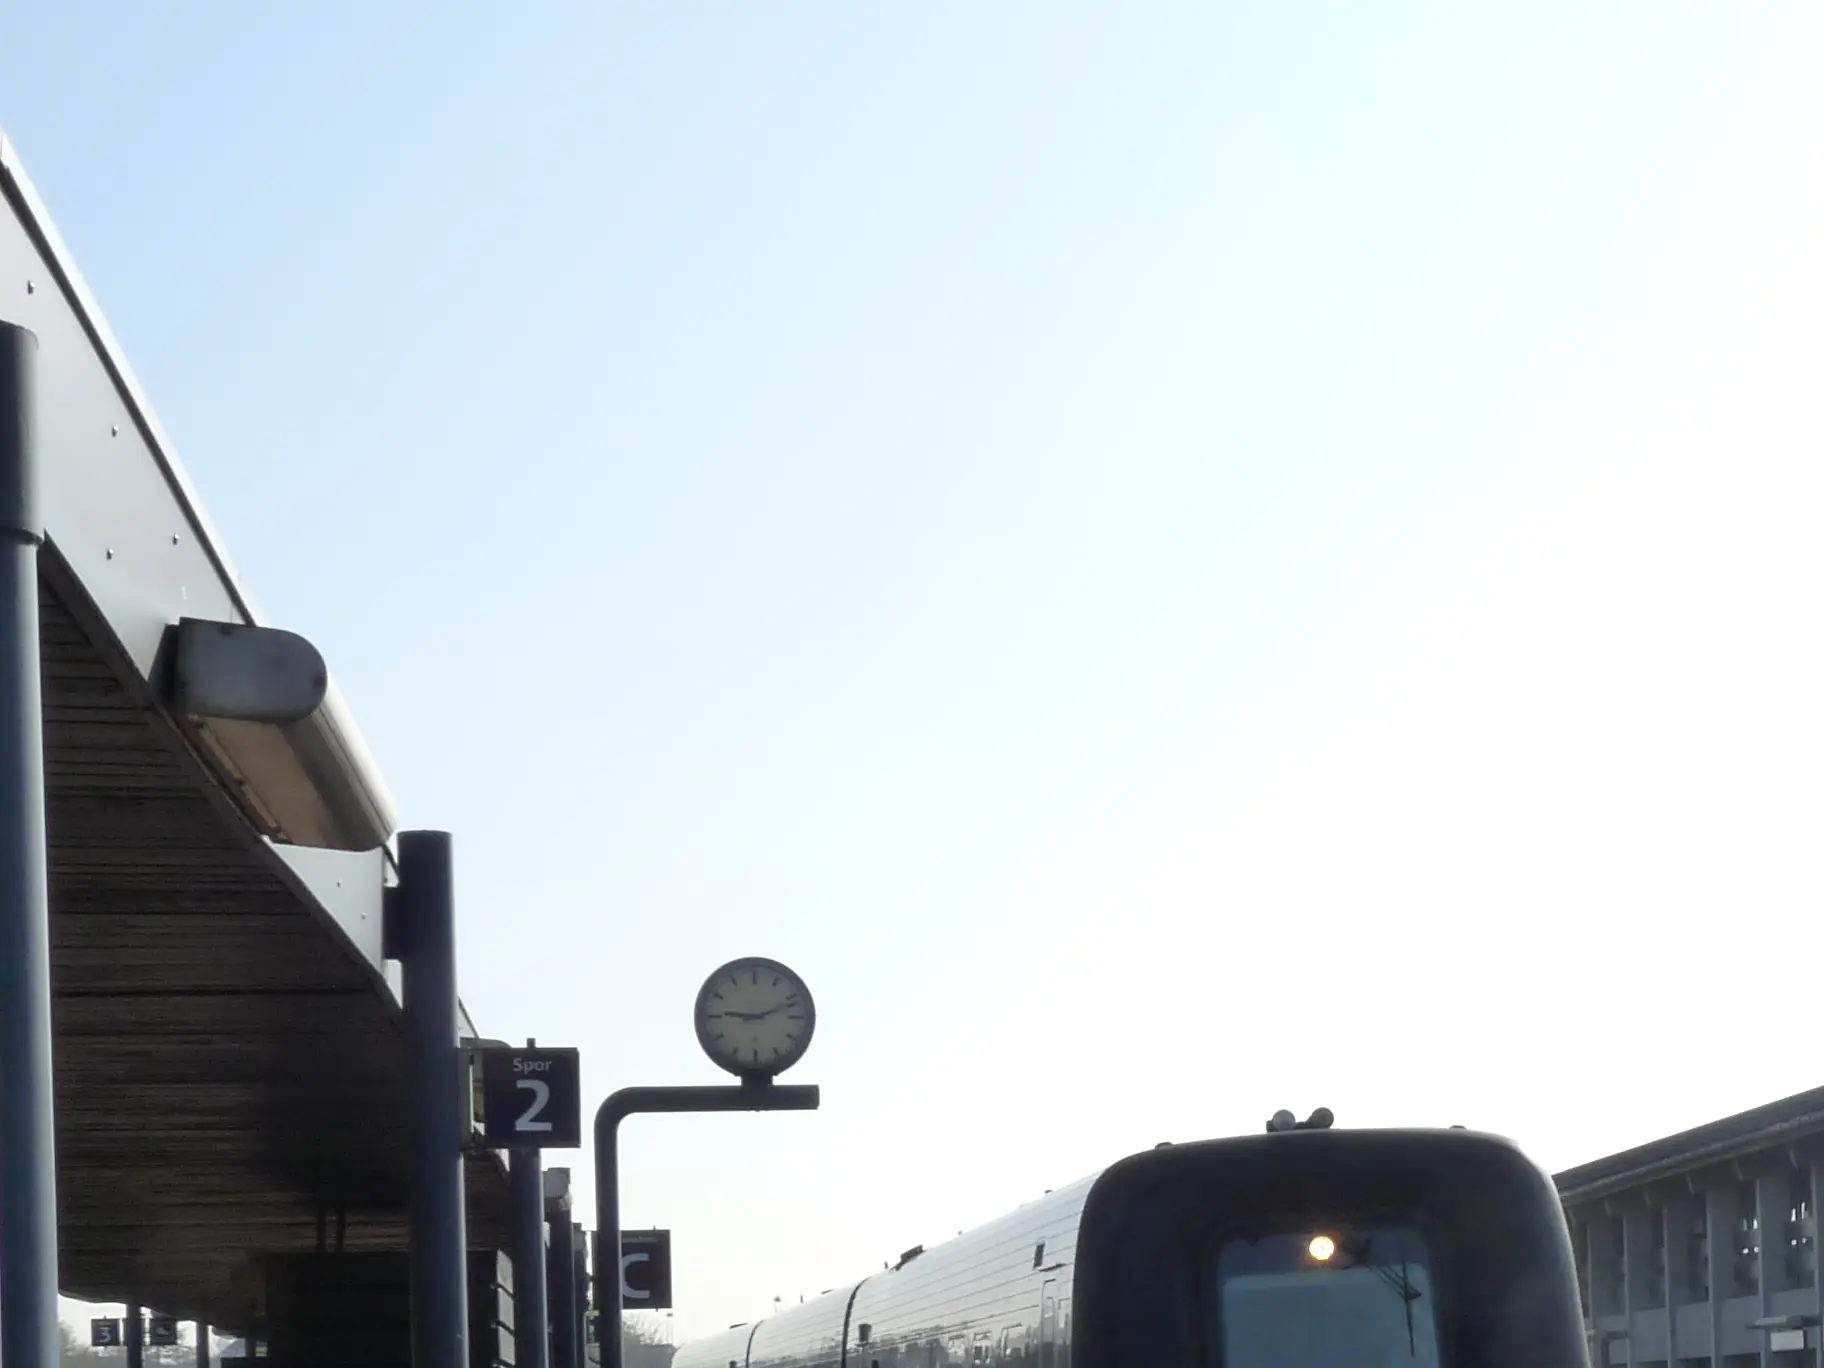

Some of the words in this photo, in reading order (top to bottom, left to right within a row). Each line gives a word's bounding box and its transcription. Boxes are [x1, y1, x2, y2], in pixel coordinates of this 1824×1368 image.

[512, 1057, 552, 1075] Spor
[514, 1079, 553, 1131] 2
[621, 1252, 651, 1299] C
[98, 1327, 112, 1343] 3
